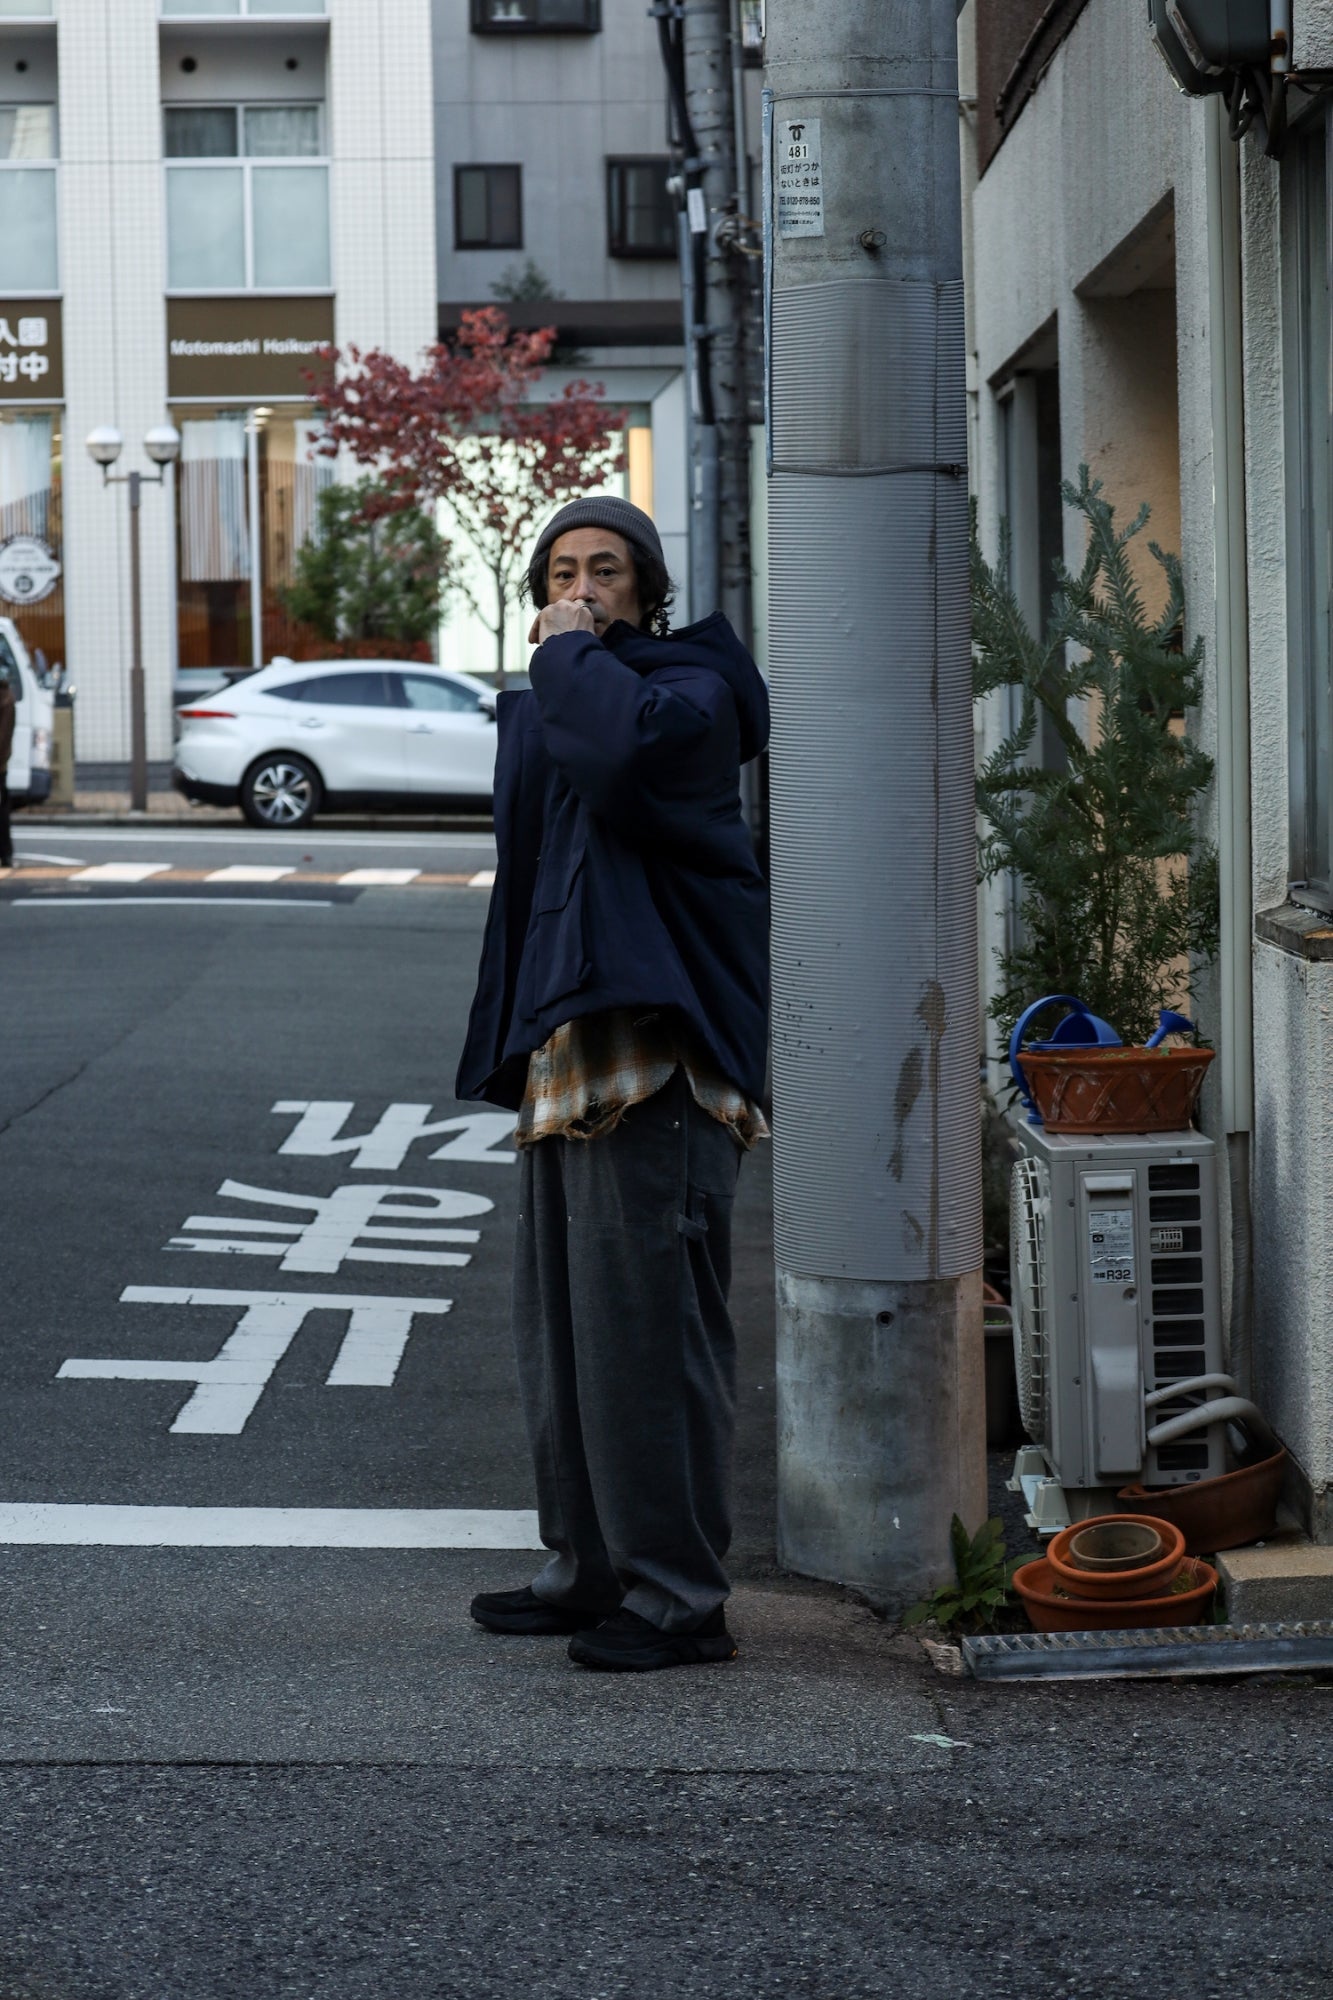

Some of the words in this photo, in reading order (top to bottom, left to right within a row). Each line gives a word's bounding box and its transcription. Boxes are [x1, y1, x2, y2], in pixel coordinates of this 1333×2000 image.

[788, 145, 807, 158] 481
[781, 177, 820, 188] ないときは
[170, 339, 260, 355] Motomachi
[1106, 1269, 1131, 1280] R32
